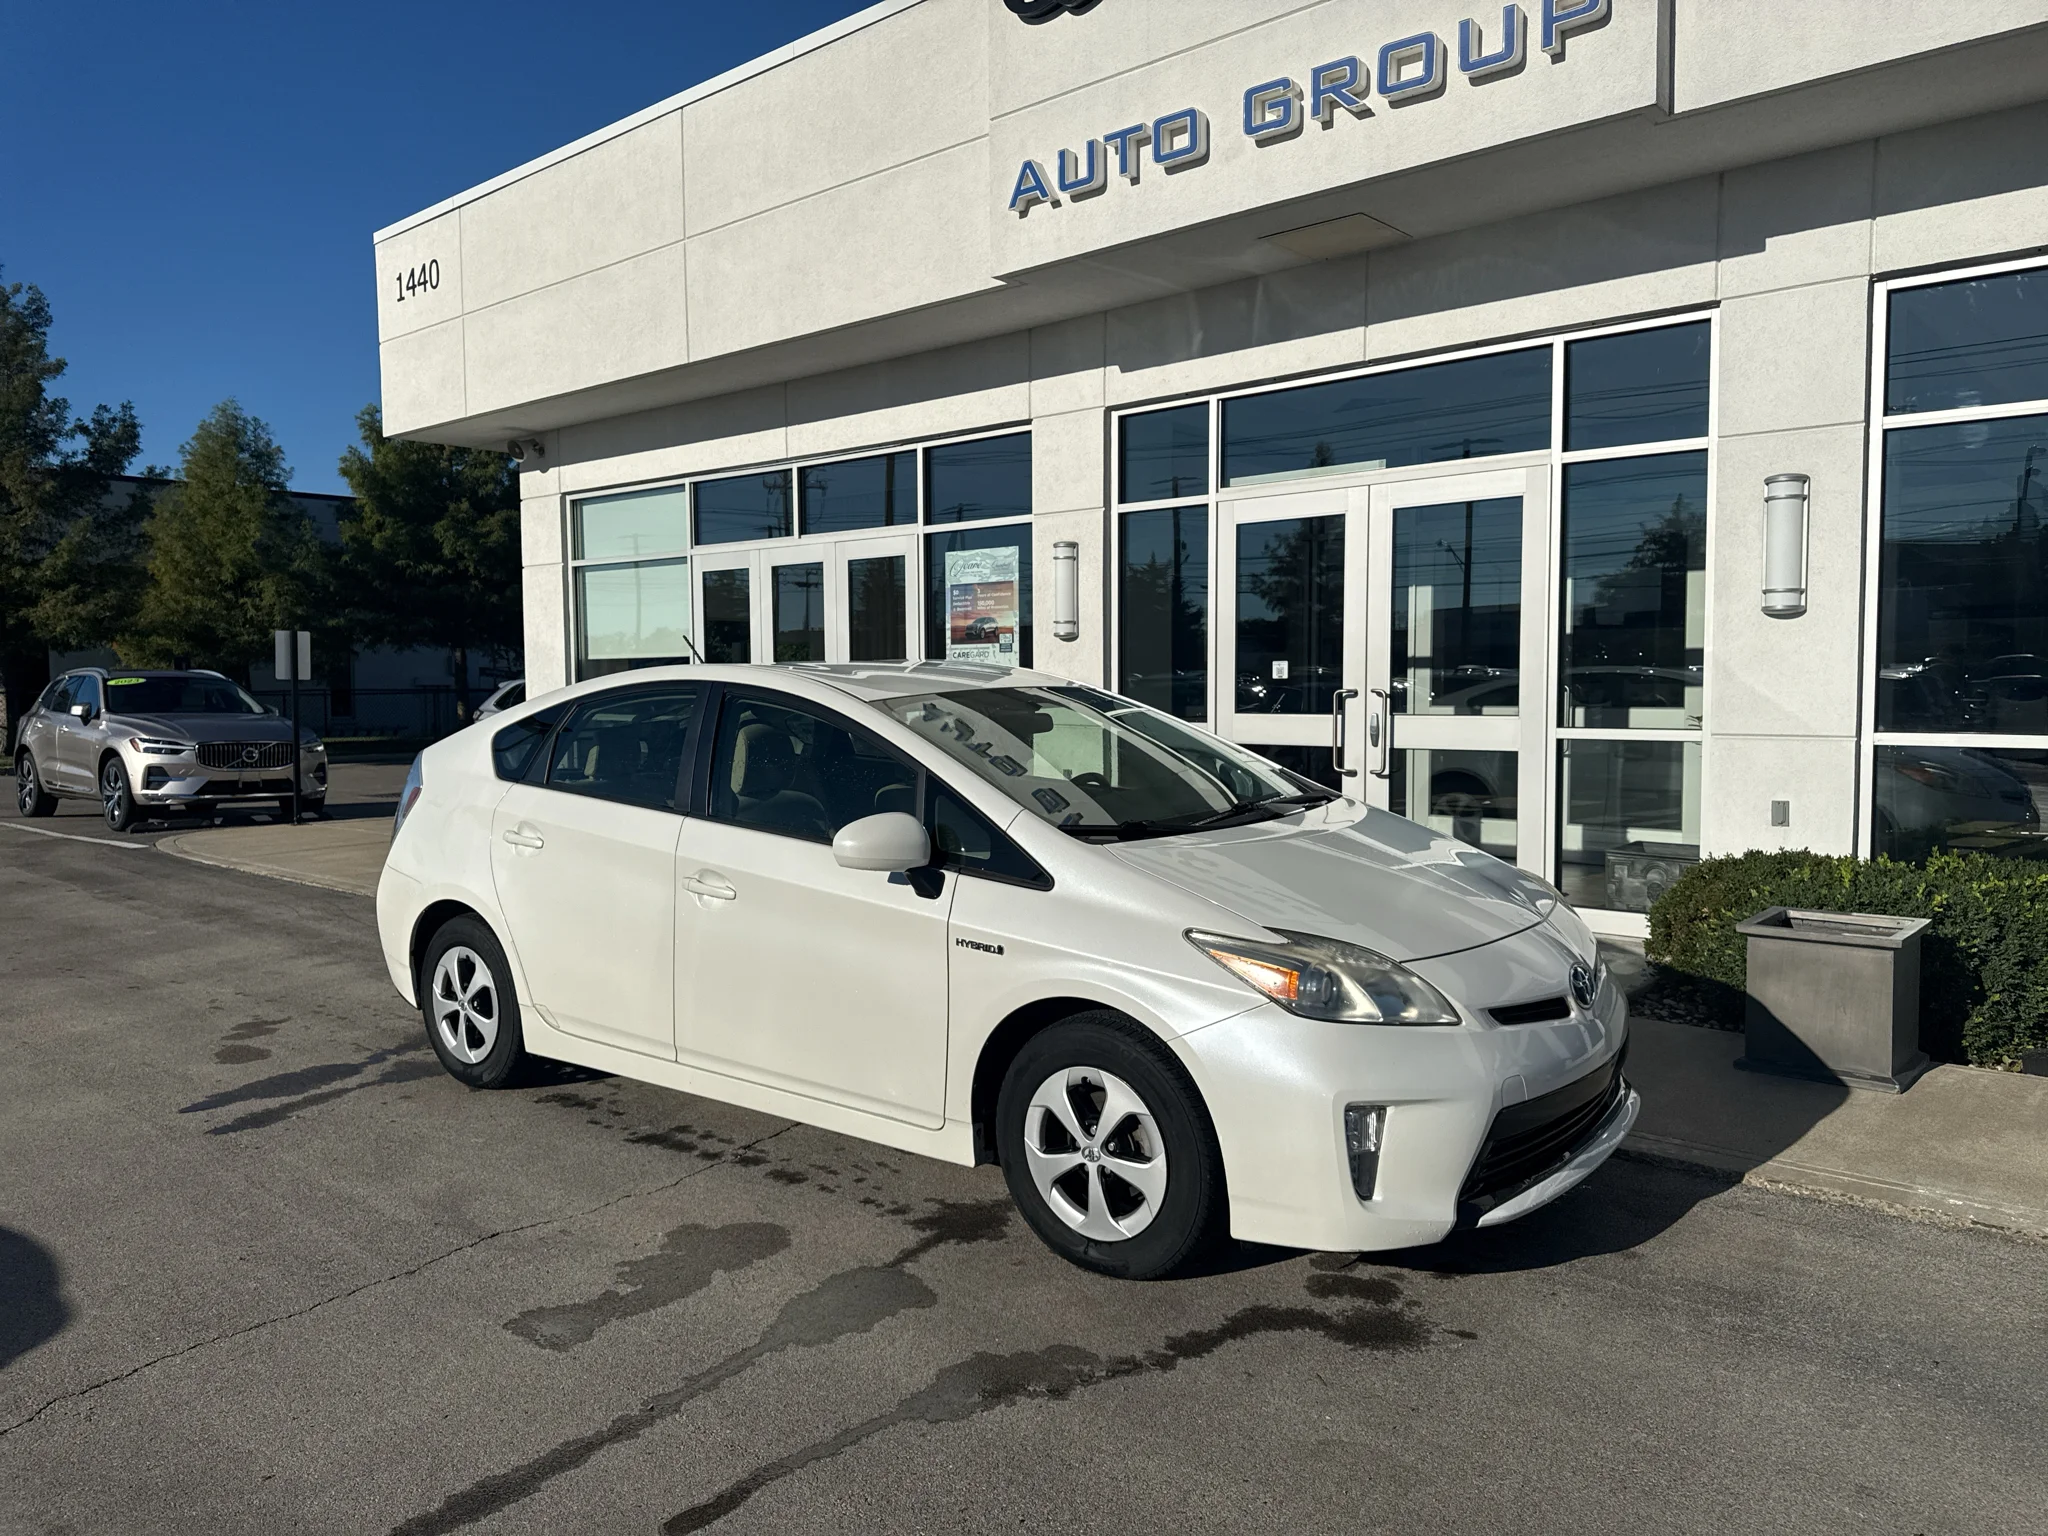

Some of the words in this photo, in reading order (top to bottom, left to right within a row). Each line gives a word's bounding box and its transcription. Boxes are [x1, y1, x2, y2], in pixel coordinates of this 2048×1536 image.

[1008, 107, 1209, 213] AUTO
[1243, 0, 1610, 140] GROUP
[396, 259, 440, 302] 1440
[952, 651, 990, 659] CAREGARD
[955, 937, 996, 954] HYBRID
